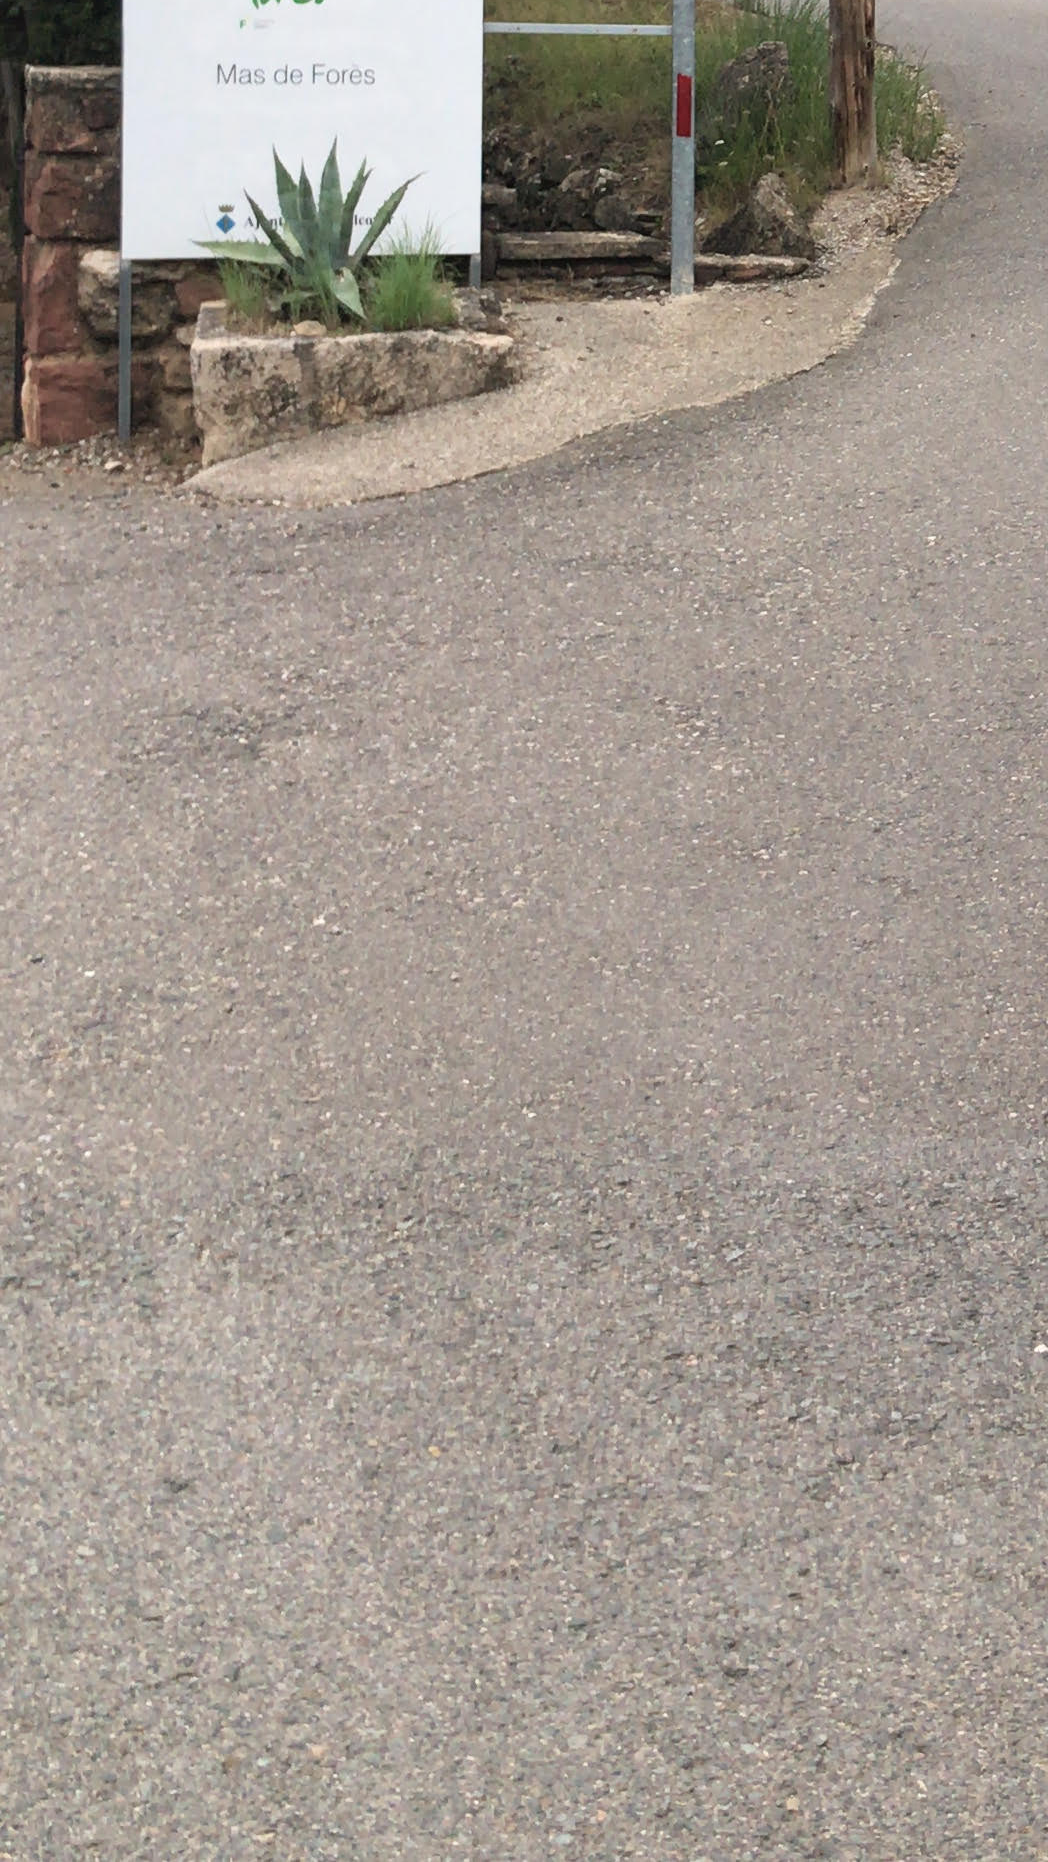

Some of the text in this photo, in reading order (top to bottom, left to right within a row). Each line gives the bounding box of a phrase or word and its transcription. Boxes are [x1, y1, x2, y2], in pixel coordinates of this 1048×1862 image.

[216, 62, 376, 86] Mas de Forès
